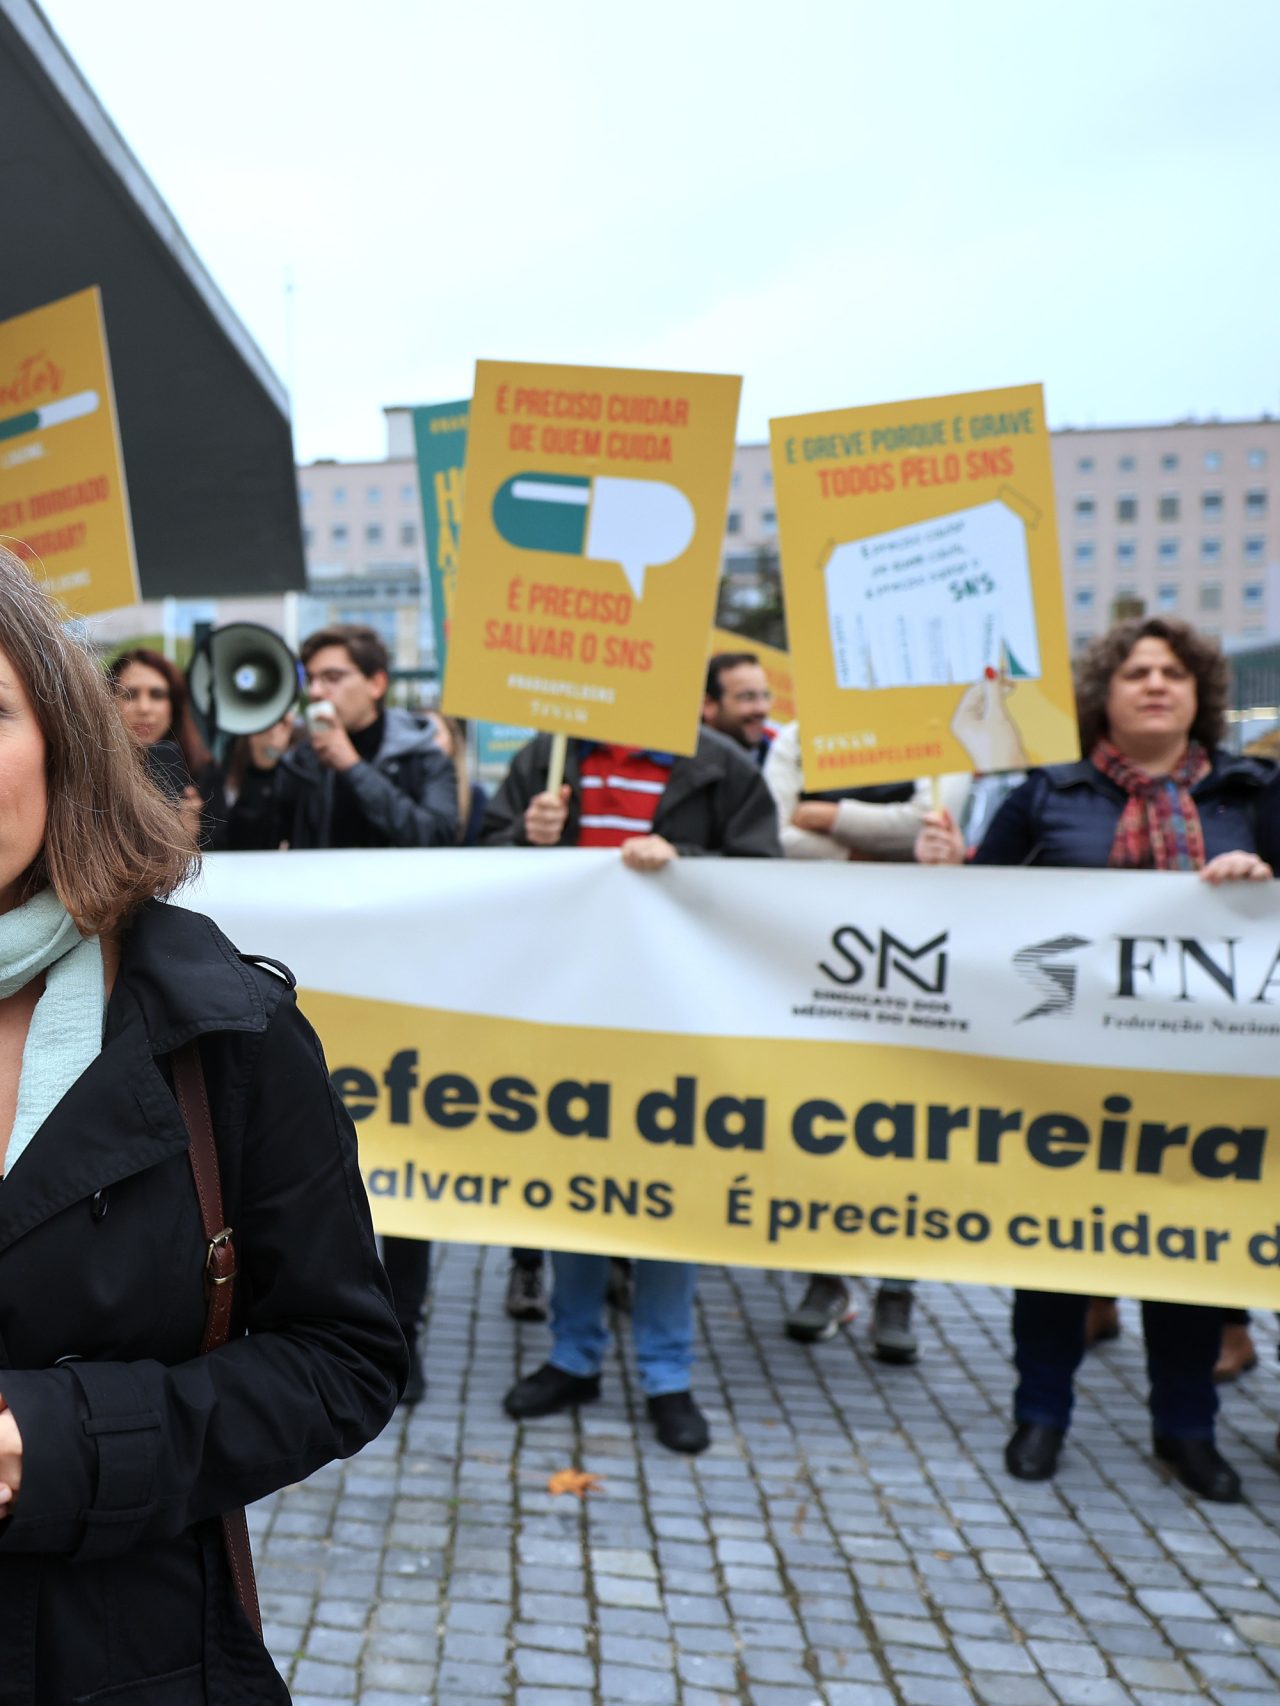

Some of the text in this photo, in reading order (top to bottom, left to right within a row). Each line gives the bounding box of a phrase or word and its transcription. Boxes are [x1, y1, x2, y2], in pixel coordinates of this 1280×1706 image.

[497, 384, 689, 427] É PRECISO CUIDAR
[509, 423, 672, 464] DE QUEM CUIDA
[786, 408, 1034, 465] É GREVE PORQUE É GRAVE
[817, 445, 1014, 498] TODOS PELO SNS
[507, 574, 632, 627] É PRECISO
[483, 619, 654, 673] SALVAR O SNS
[909, 1015, 969, 1032] NORTE
[635, 1076, 766, 1151] da
[791, 1094, 1267, 1182] carreira
[523, 1180, 552, 1210] o
[568, 1175, 674, 1221] SNS
[726, 1175, 753, 1228] É
[767, 1194, 992, 1244] preciso
[1007, 1206, 1230, 1264] cuidar
